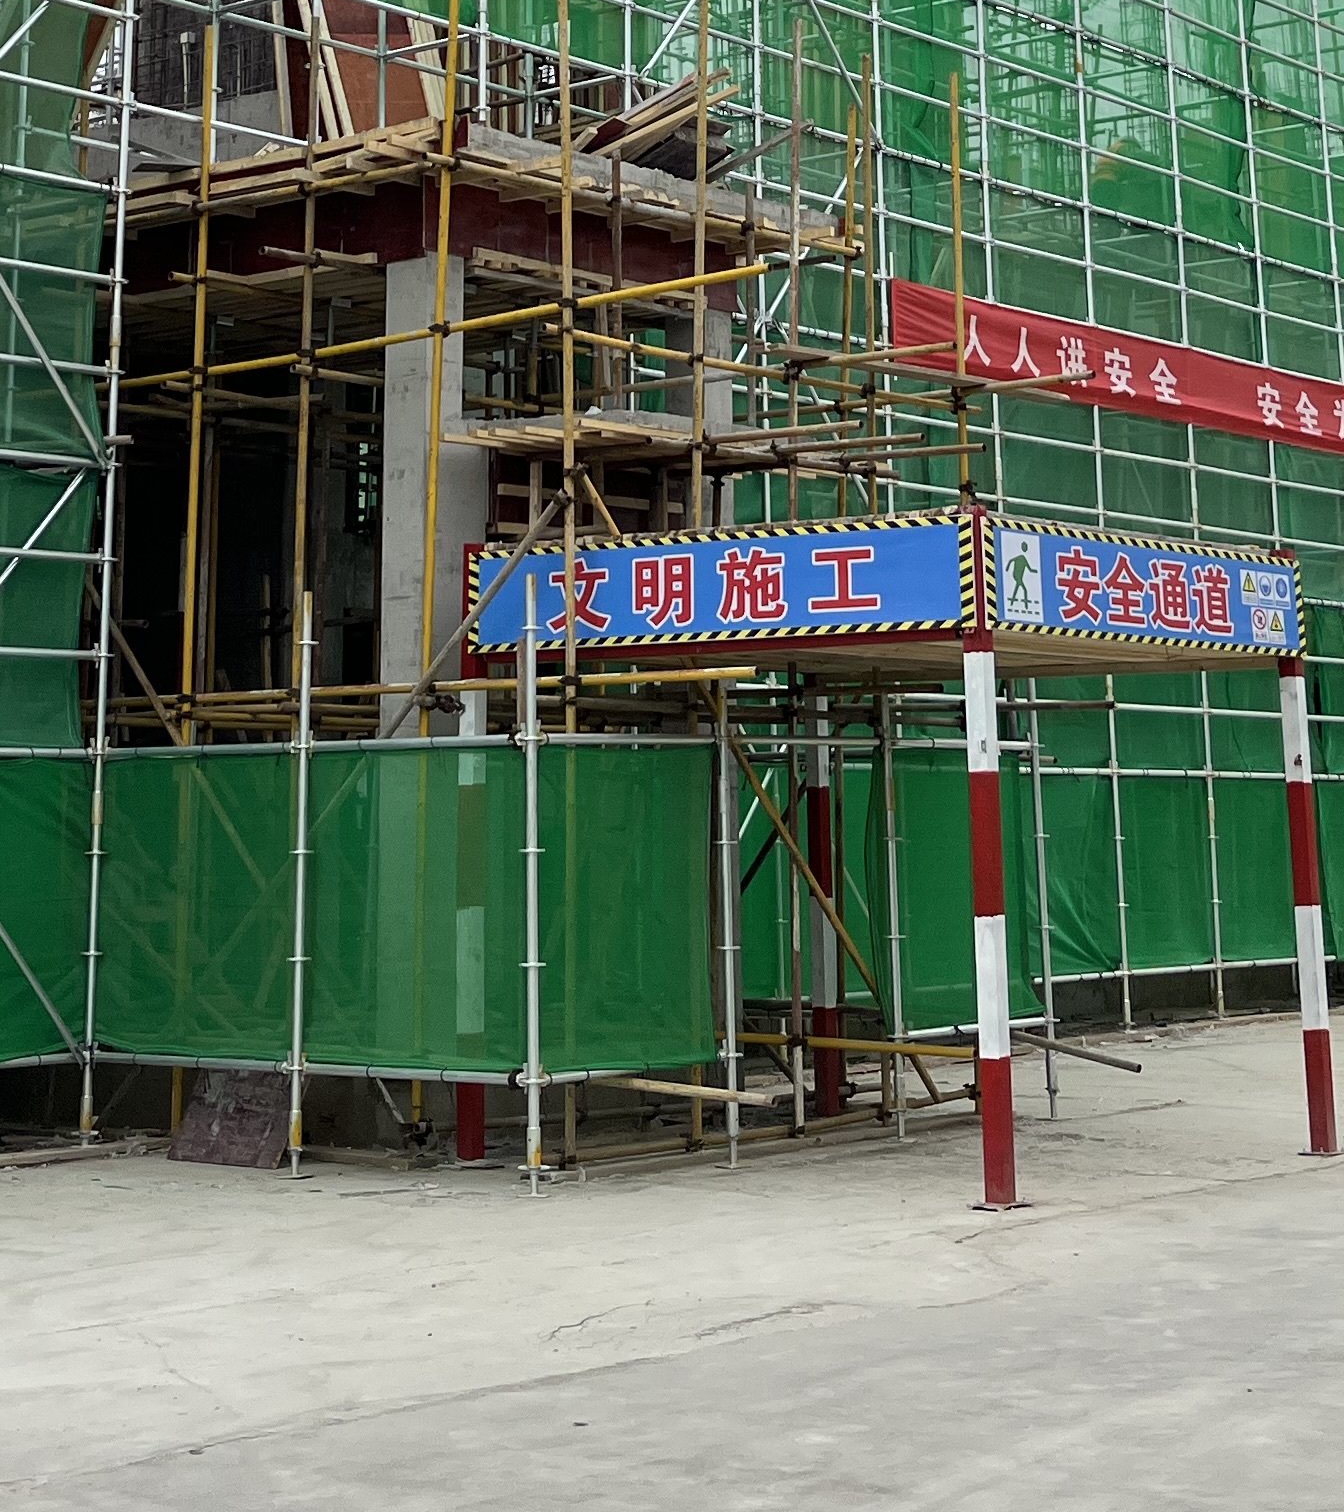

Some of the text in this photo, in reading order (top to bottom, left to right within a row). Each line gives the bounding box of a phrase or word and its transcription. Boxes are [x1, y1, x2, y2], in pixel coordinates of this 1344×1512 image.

[963, 314, 1182, 405] 人人讲安全
[547, 545, 881, 632] 文明施工
[1056, 545, 1235, 637] 安全通道
